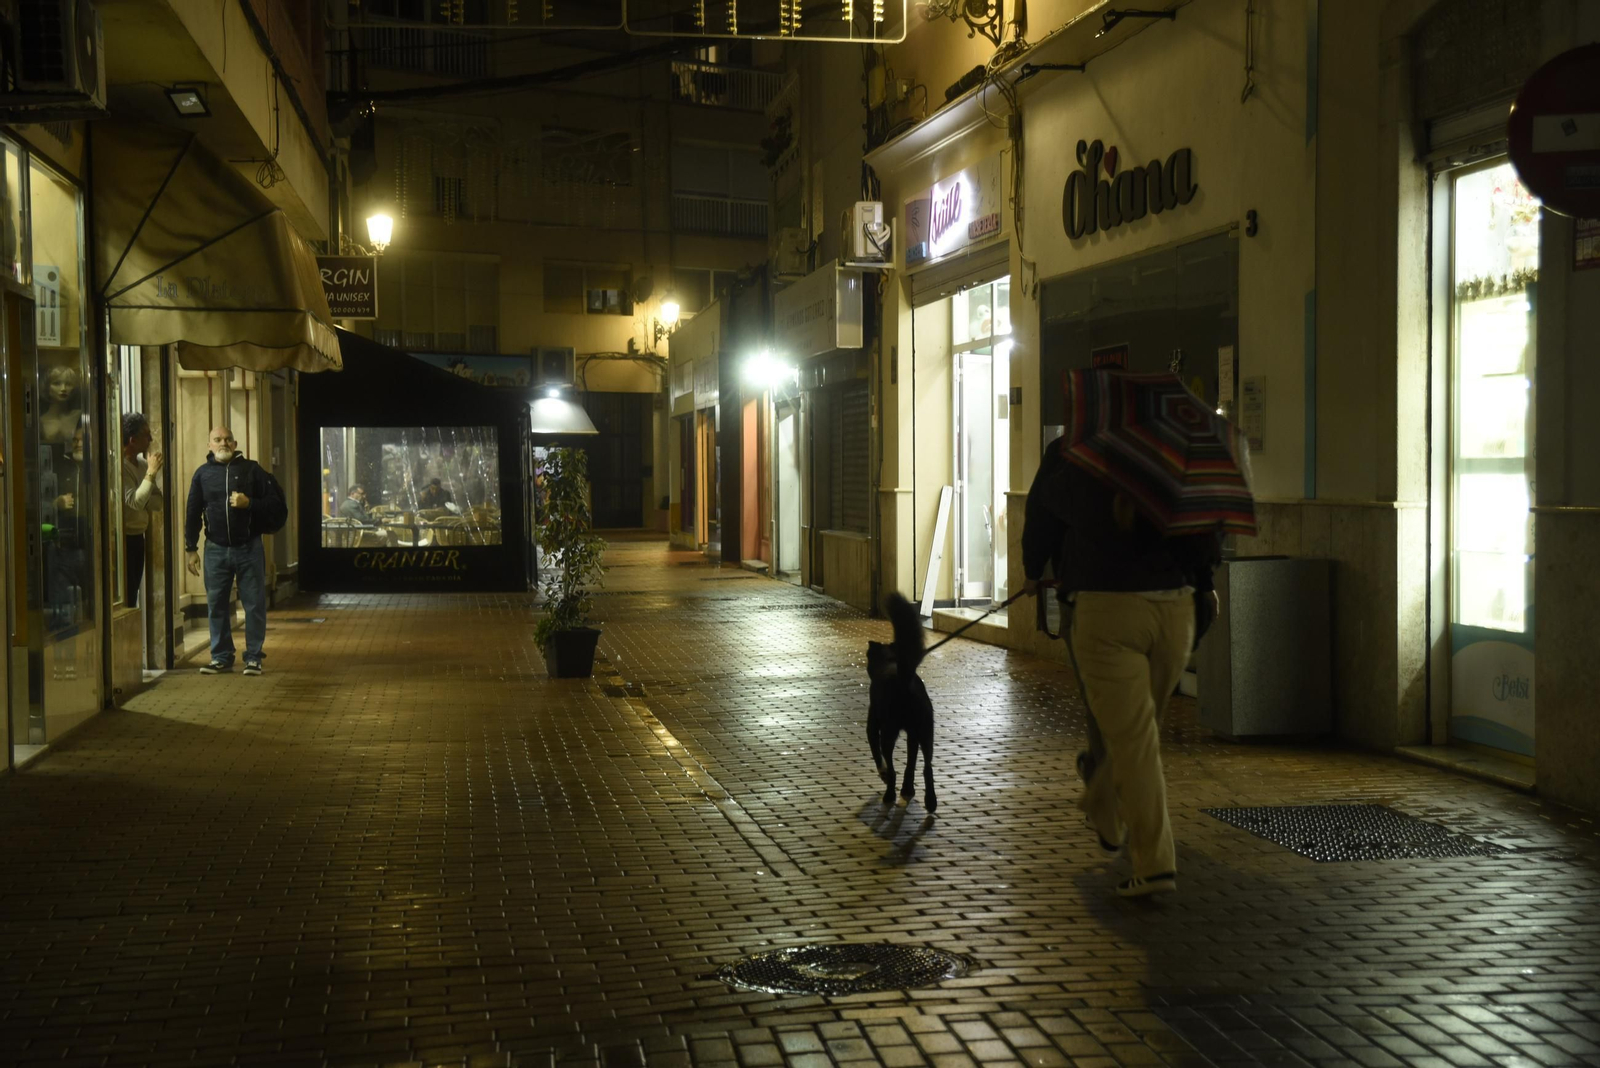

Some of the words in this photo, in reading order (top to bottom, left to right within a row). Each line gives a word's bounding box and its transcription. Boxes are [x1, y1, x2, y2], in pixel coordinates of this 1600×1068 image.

[1245, 209, 1258, 237] 3
[336, 292, 370, 302] UNISEX
[354, 550, 460, 571] GRANIER
